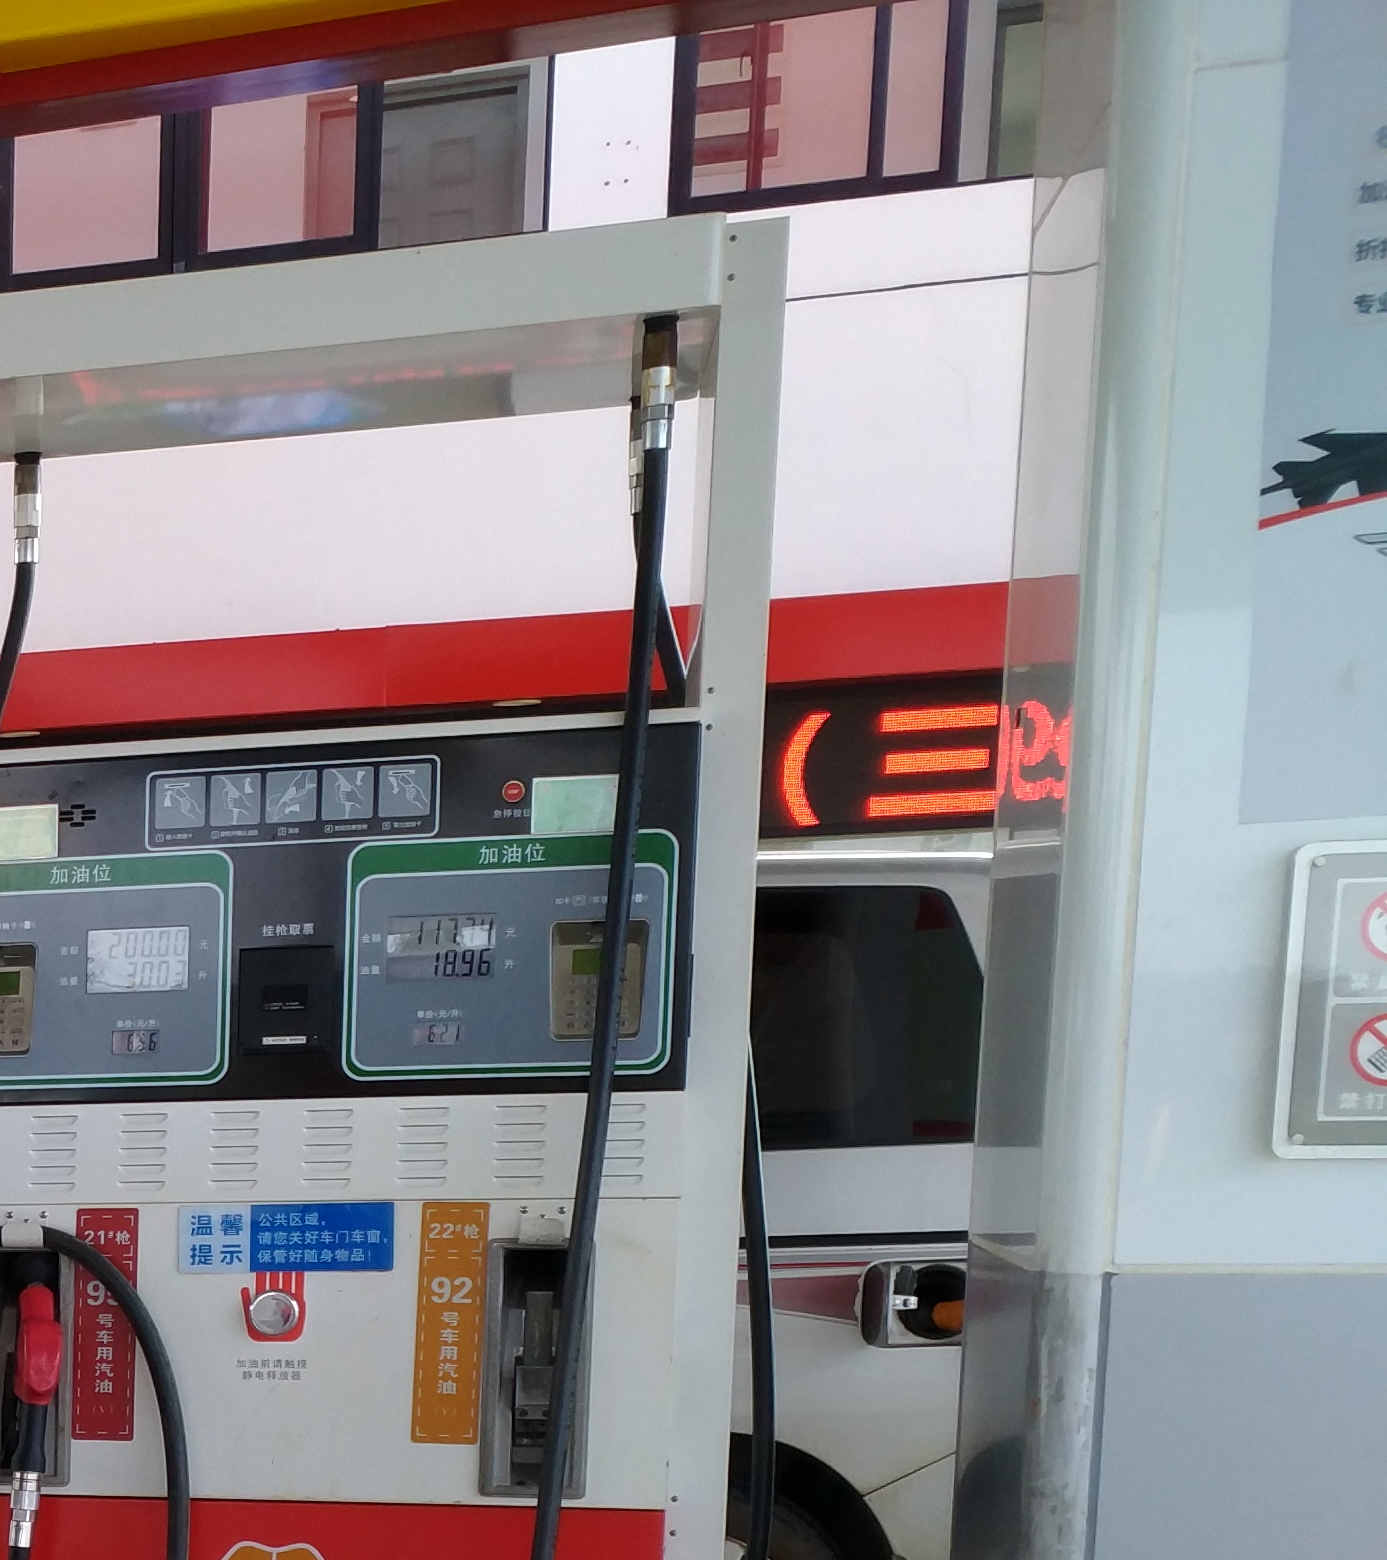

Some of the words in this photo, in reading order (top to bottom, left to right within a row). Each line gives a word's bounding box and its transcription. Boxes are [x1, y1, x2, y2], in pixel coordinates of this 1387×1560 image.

[478, 843, 546, 865] 加油位
[49, 864, 112, 885] 加油位
[433, 948, 491, 978] 18.96
[189, 1213, 244, 1237] 温馨
[189, 1244, 244, 1266] 提示
[86, 1280, 120, 1306] 9
[430, 1277, 473, 1304] 92
[94, 1313, 115, 1394] 号车用汽油
[236, 1359, 308, 1370] 加油前请触摸
[436, 1311, 460, 1395] 号车用汽油
[242, 1371, 302, 1381] 静电释放器
